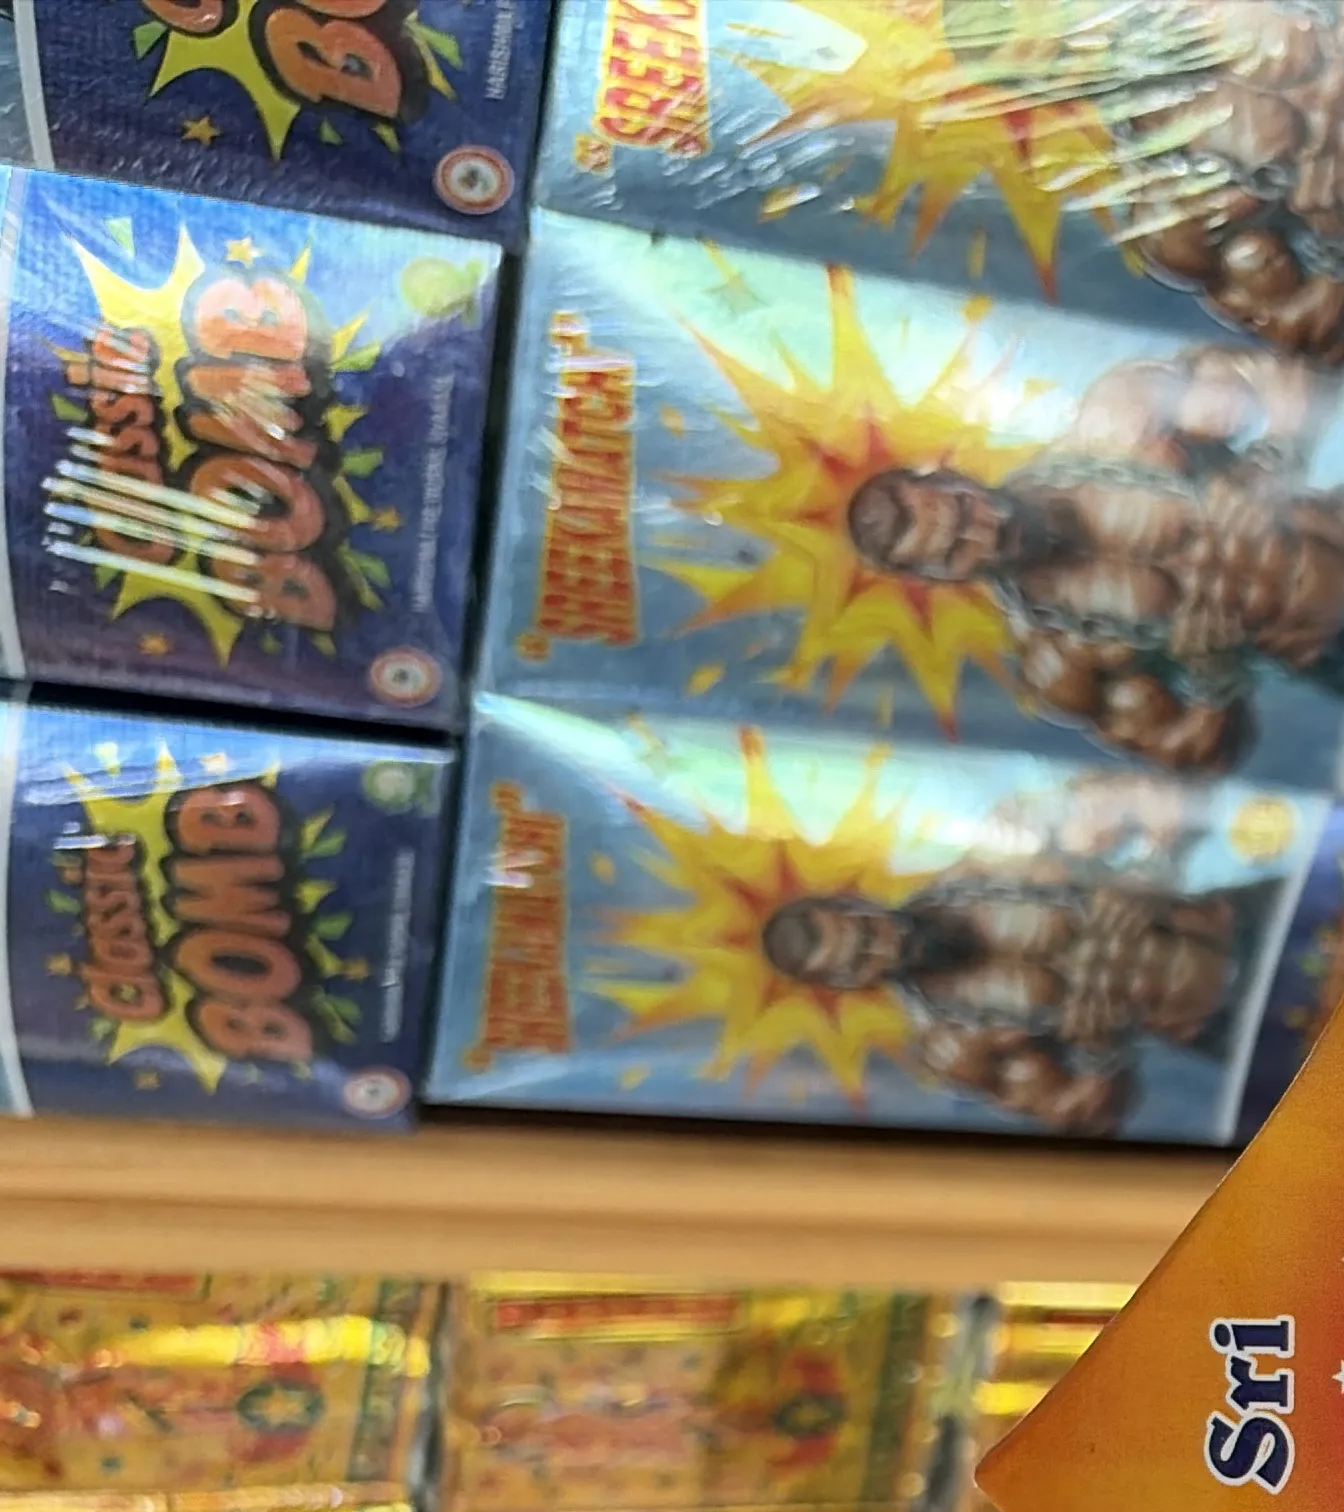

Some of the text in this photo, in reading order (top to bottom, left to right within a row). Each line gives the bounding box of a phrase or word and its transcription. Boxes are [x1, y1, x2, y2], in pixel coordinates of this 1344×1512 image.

[264, 0, 402, 118] B
[64, 326, 174, 561] Cssic
[188, 277, 337, 629] BOMB
[168, 782, 313, 1060] BOMB
[1204, 1315, 1295, 1494] Sri
